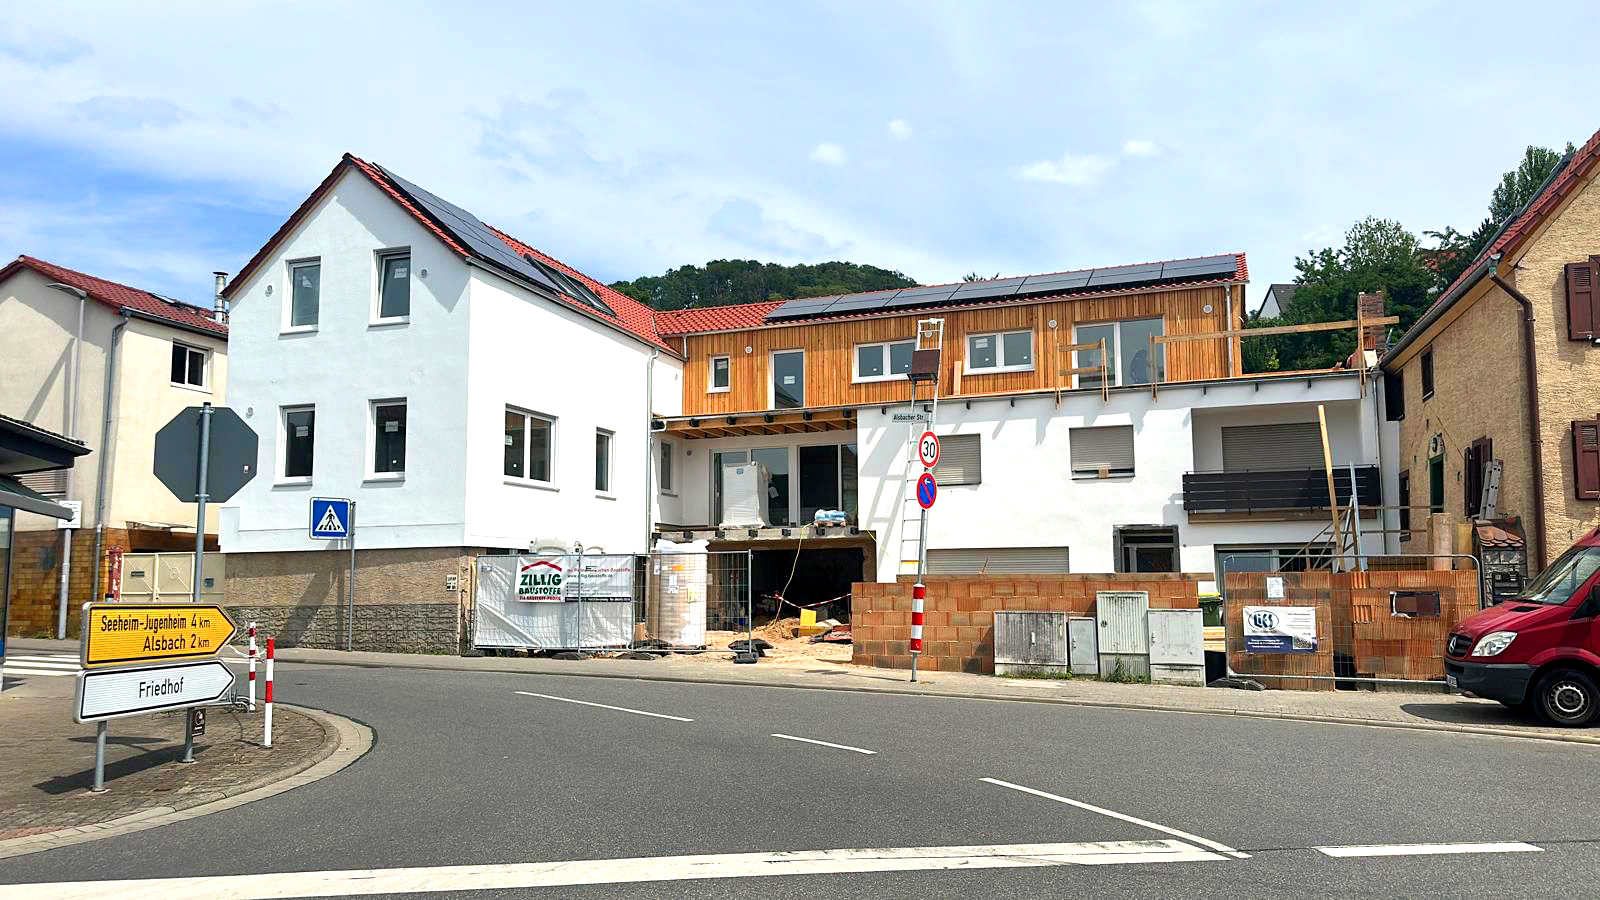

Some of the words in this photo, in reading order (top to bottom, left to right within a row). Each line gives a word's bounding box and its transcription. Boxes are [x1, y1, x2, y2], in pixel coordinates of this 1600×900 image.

[893, 413, 915, 421] Alsbacher
[923, 440, 936, 458] 30
[520, 573, 562, 586] ZILLIG
[519, 587, 561, 595] BAUSTOFFE
[101, 613, 187, 634] Seeheim-Jugenheim
[191, 613, 197, 628] 4
[199, 616, 211, 628] km
[143, 634, 186, 652] Alsbach
[190, 633, 197, 648] 2
[198, 637, 210, 648] km
[138, 676, 184, 698] Friedhof
